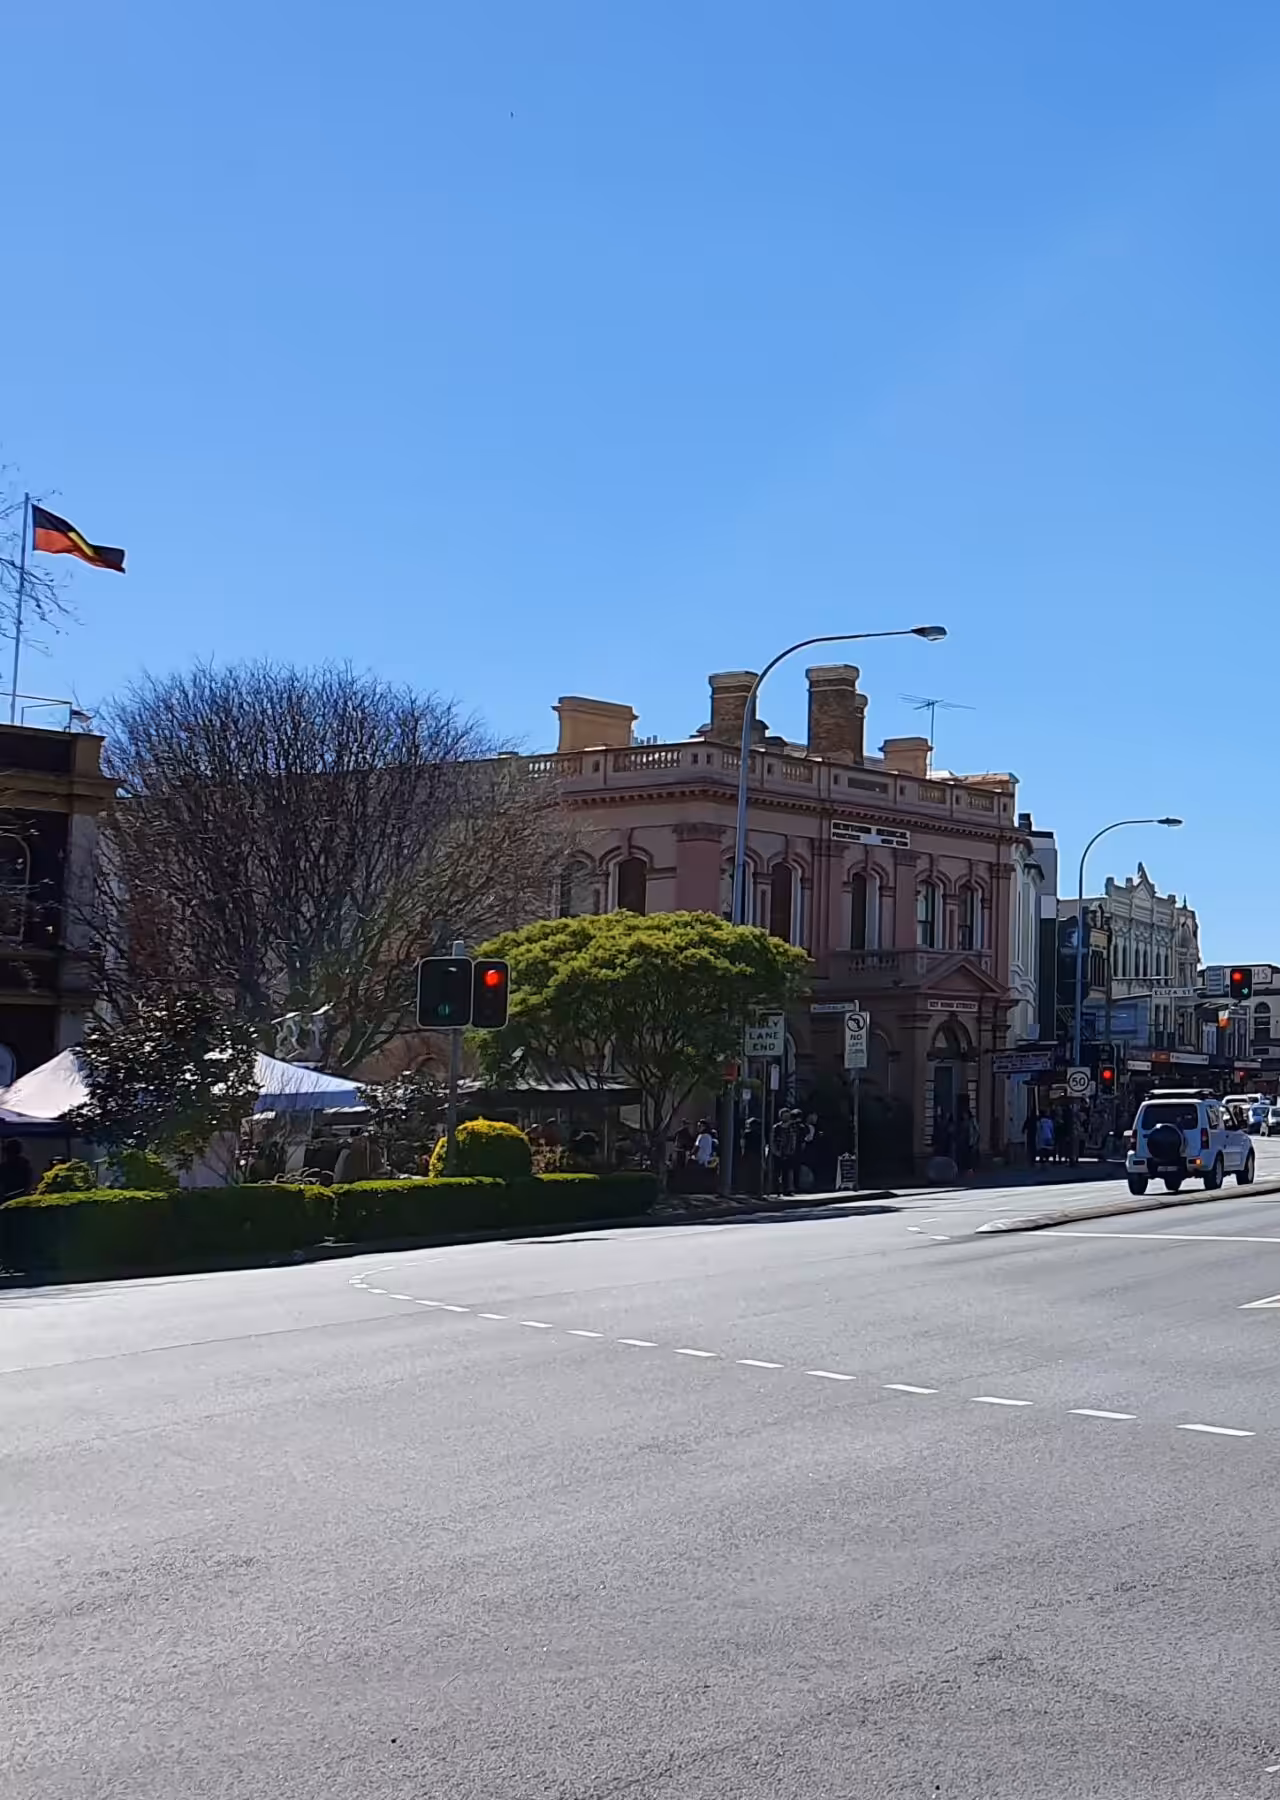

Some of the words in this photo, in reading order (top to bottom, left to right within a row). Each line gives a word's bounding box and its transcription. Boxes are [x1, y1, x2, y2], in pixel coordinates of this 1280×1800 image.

[1154, 988, 1178, 996] ELIZA
[1183, 988, 1191, 996] ST
[748, 1031, 780, 1041] LANE
[849, 1033, 863, 1041] NO
[753, 1042, 777, 1052] END
[1071, 1076, 1087, 1088] 50
